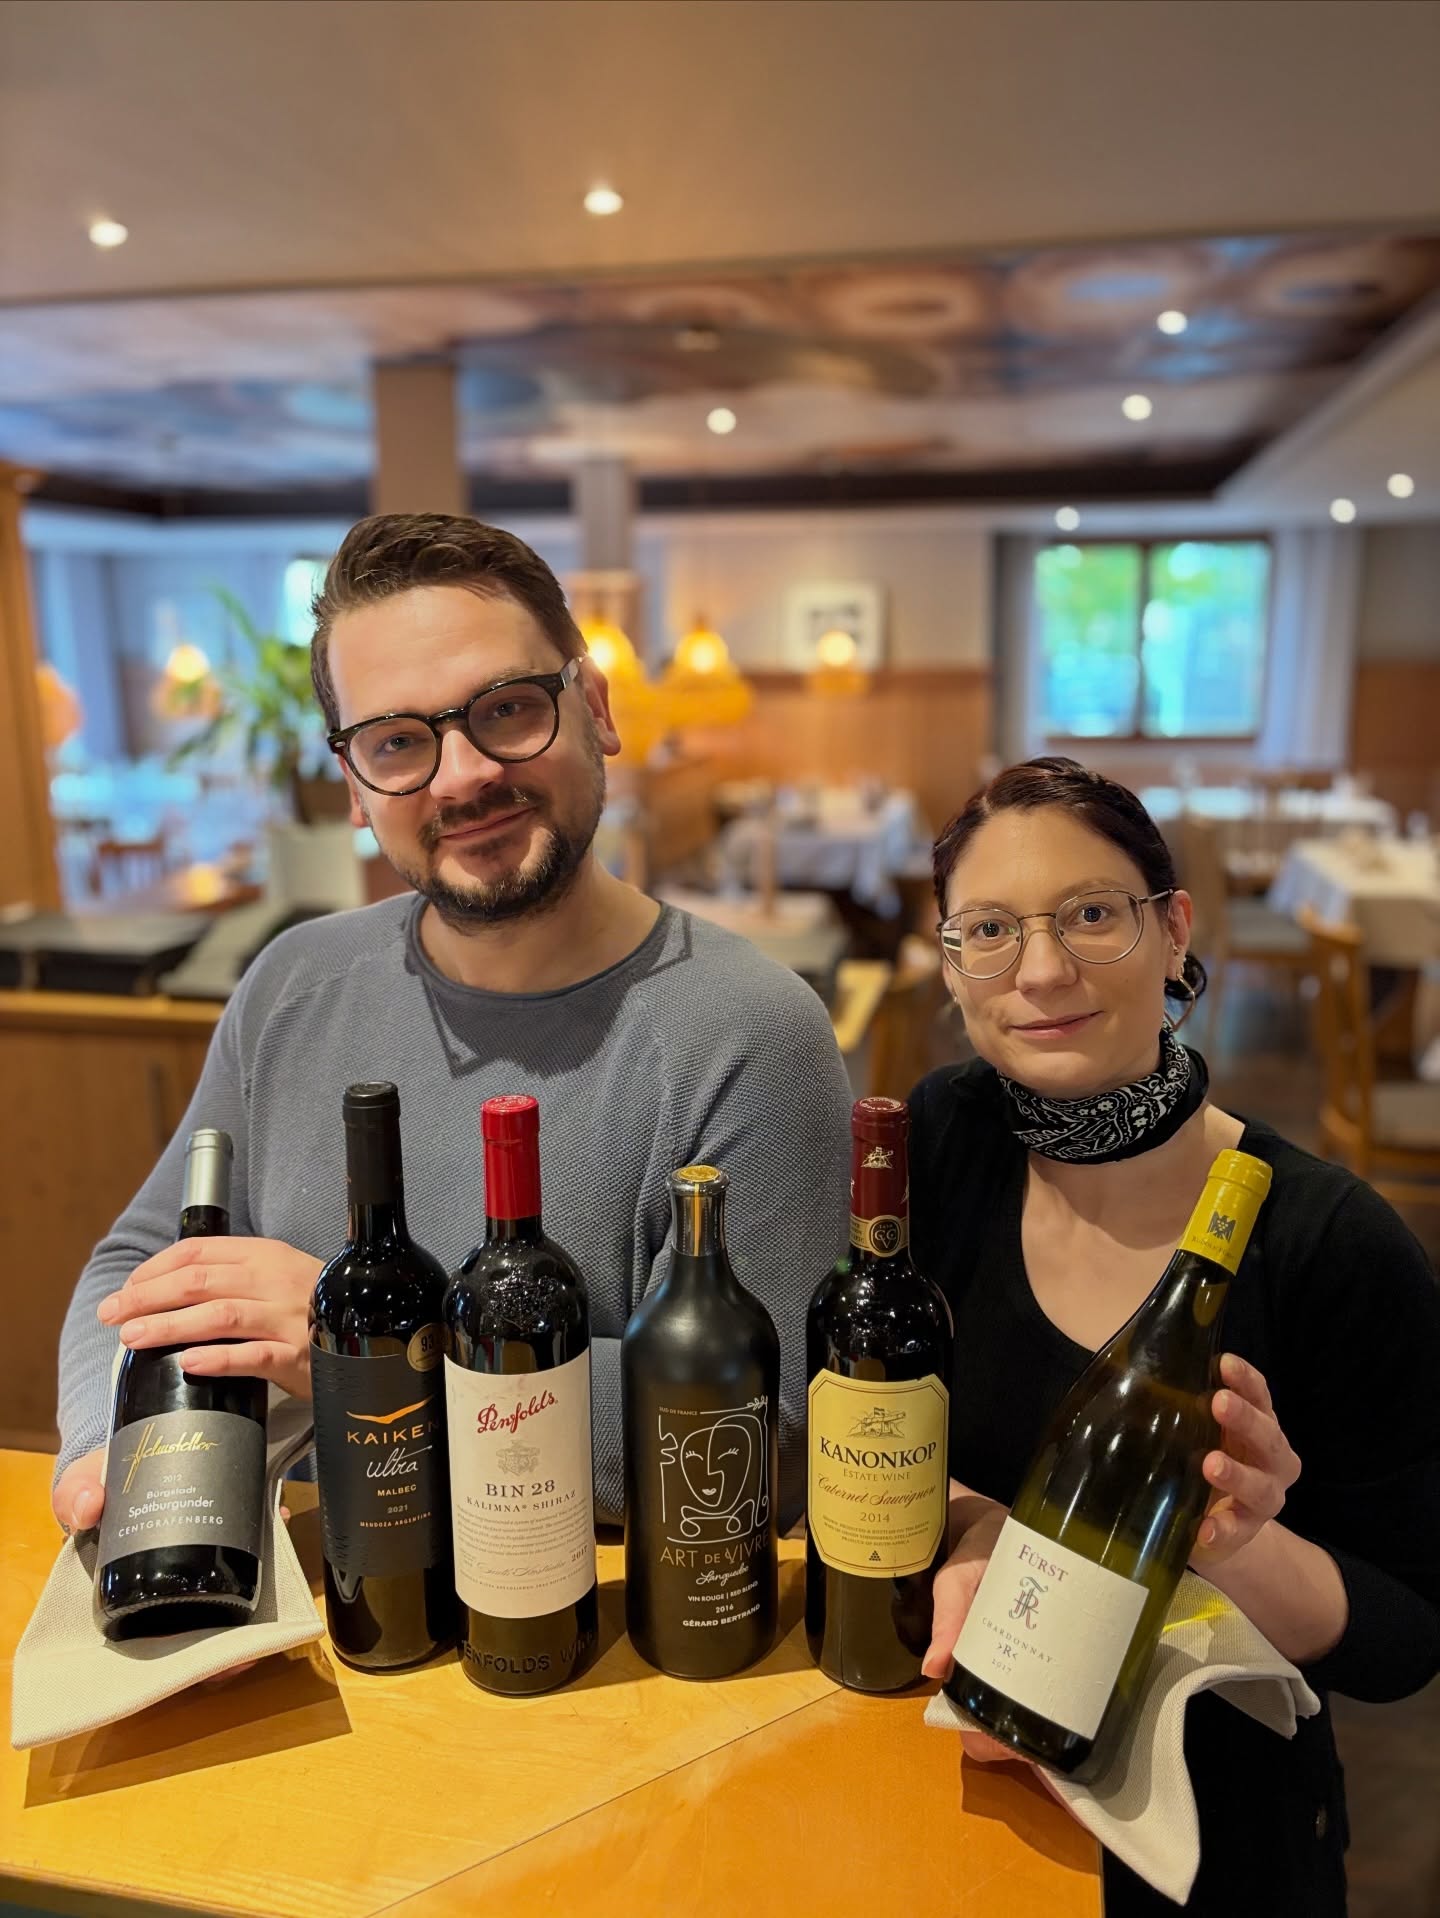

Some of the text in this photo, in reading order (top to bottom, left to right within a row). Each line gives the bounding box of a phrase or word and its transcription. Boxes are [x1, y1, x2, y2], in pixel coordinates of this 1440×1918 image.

[477, 1389, 557, 1434] Penfolds
[347, 1421, 440, 1445] KAIKEN
[366, 1445, 433, 1478] ultra
[820, 1436, 937, 1469] KANONKOP
[843, 1469, 911, 1481] ESTATE WINE
[377, 1484, 417, 1497] MALBEC
[486, 1480, 556, 1498] BIN 28
[533, 1489, 576, 1511] SHIRAZ
[817, 1473, 937, 1510] Cabernet Sauvignon
[128, 1496, 214, 1519] Spätburgunder
[387, 1504, 408, 1514] 2021
[860, 1512, 890, 1523] 2014
[118, 1515, 224, 1538] CENTGRAFENBERG
[660, 1546, 699, 1568] ART
[704, 1553, 721, 1565] DE
[1018, 1544, 1069, 1582] FÜRST
[701, 1594, 724, 1602] ROUGE
[715, 1603, 734, 1614] 2016
[720, 1603, 760, 1625] BERTRAND
[982, 1617, 1053, 1663] CHARDONNAY
